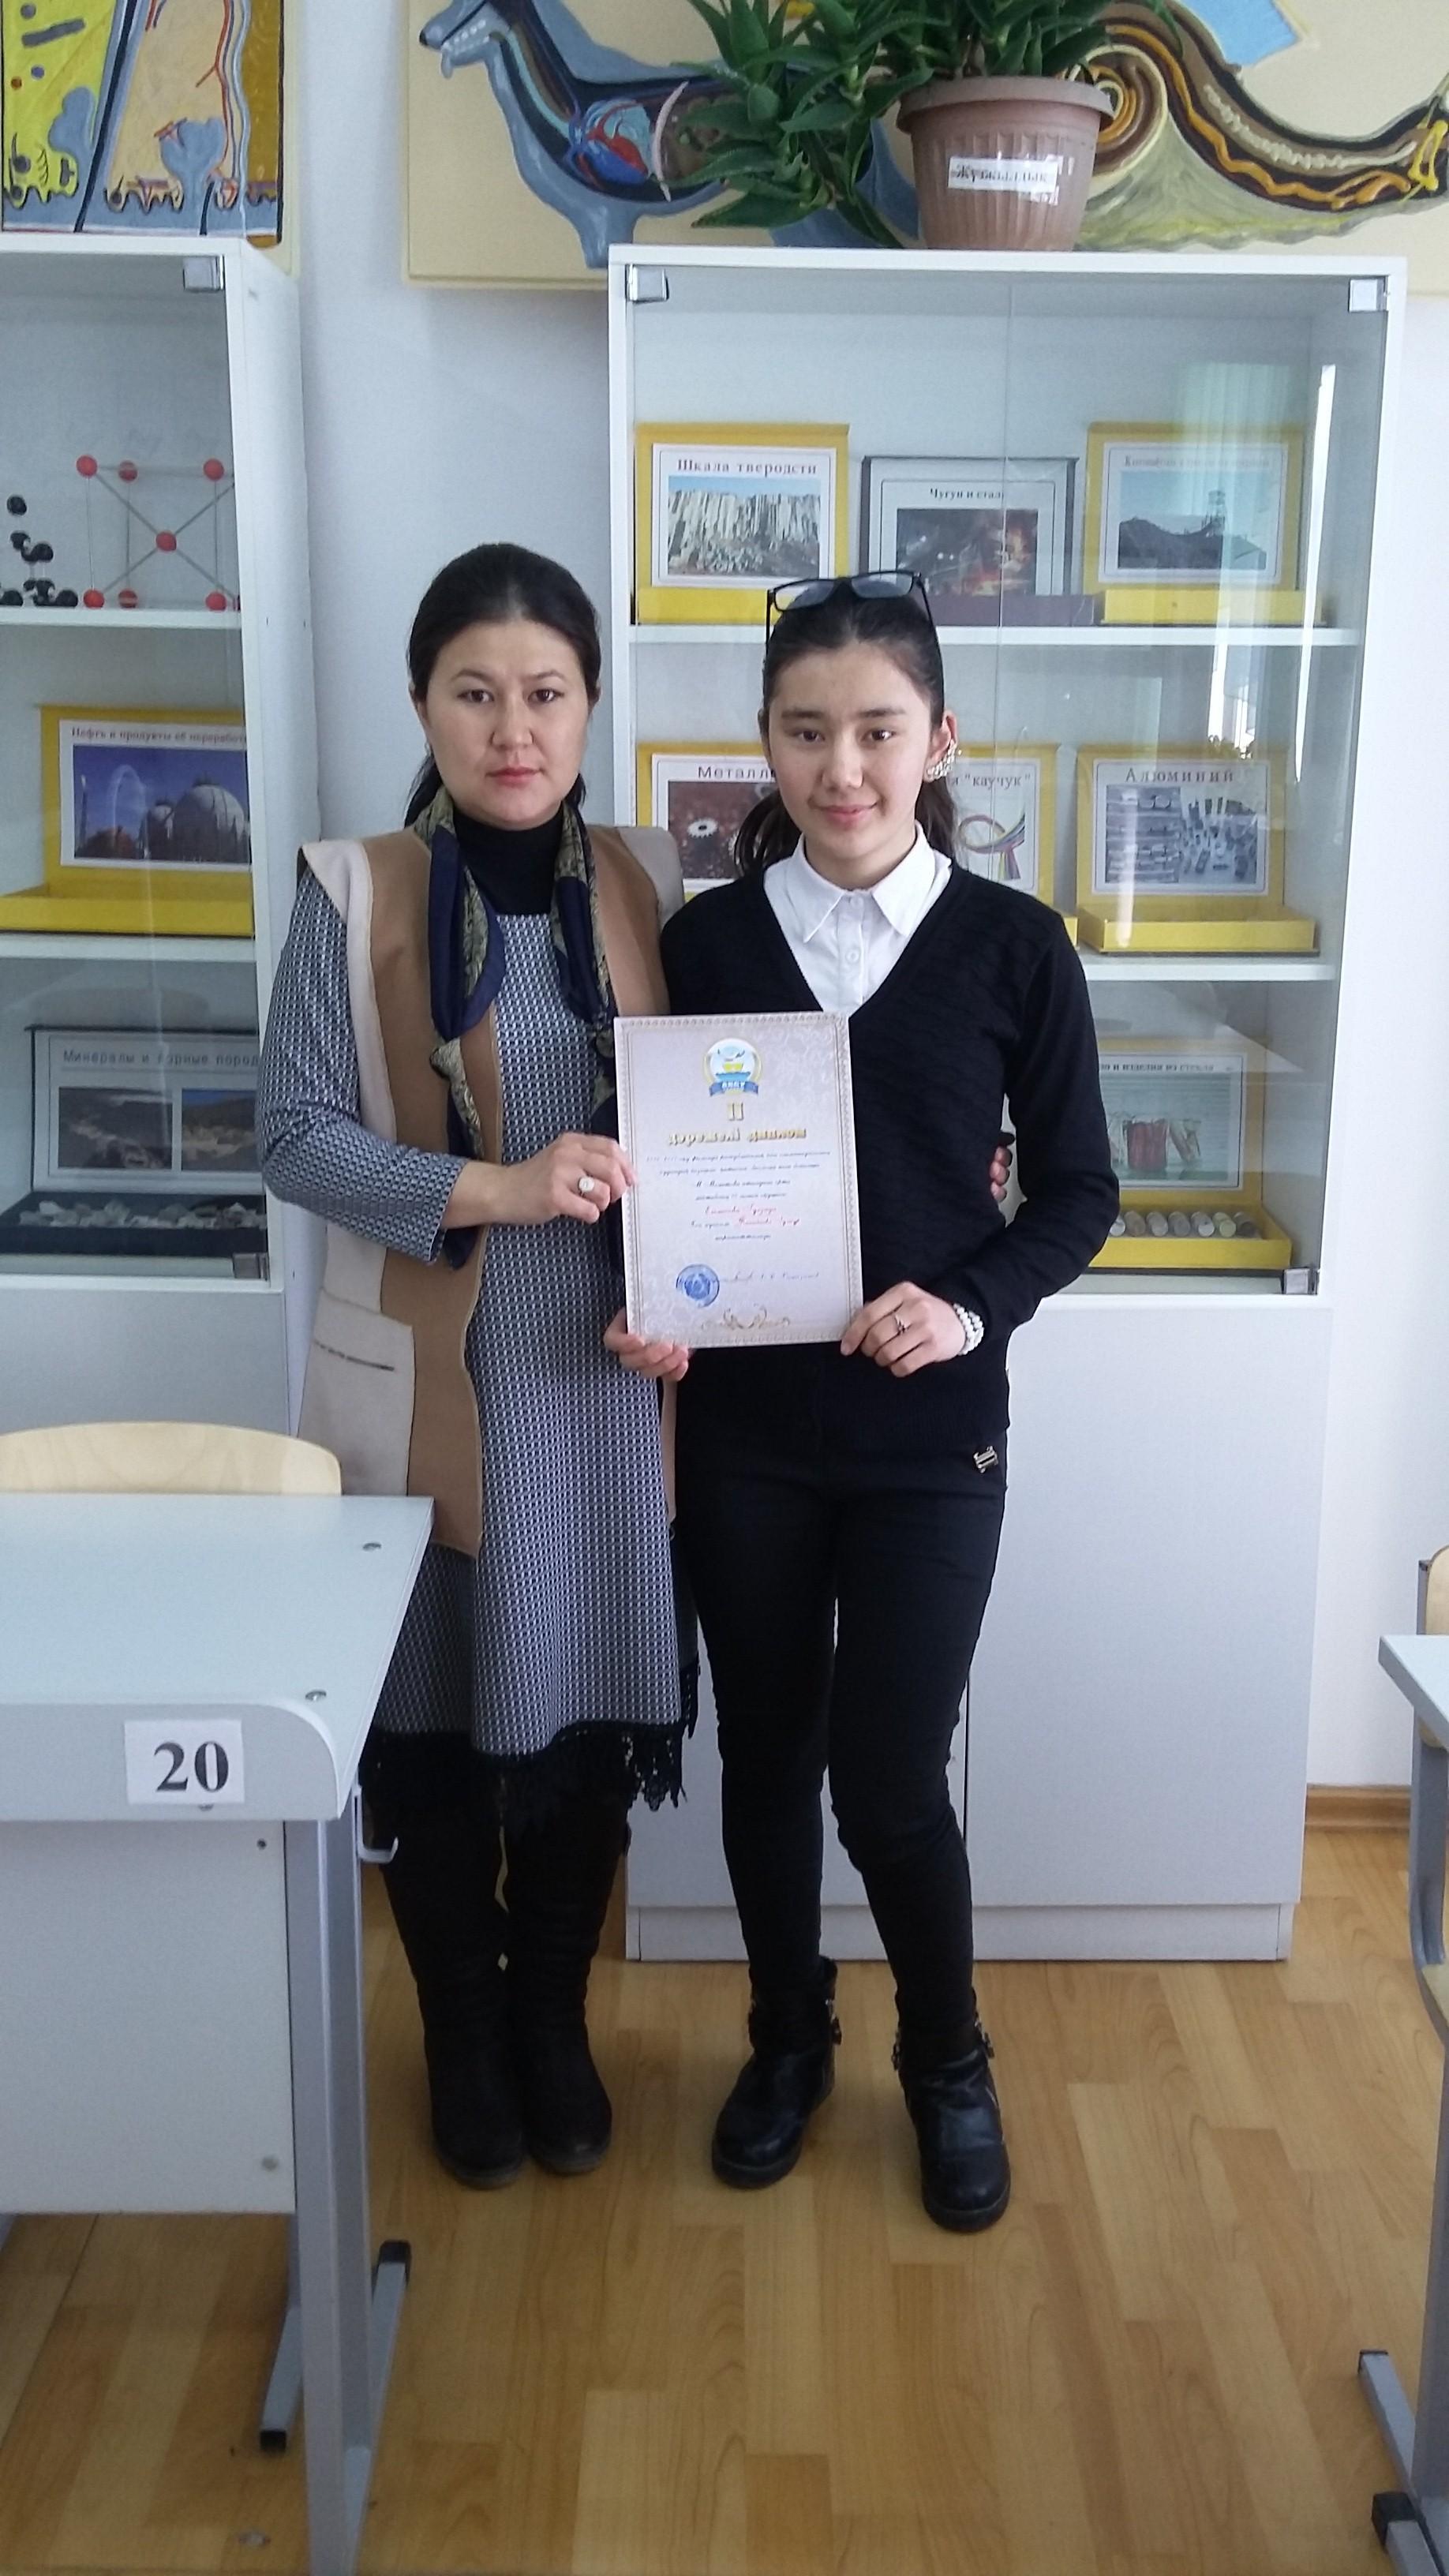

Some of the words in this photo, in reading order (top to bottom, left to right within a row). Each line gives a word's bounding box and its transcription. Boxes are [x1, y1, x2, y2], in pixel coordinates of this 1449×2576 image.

[677, 459, 729, 473] Шкала
[930, 488, 963, 501] Чугун
[698, 766, 775, 780] Металл
[1125, 767, 1234, 783] Алюминий
[63, 1050, 135, 1064] Минералы
[141, 1054, 150, 1063] и
[215, 1054, 261, 1067] пород
[154, 1741, 229, 1792] 20
